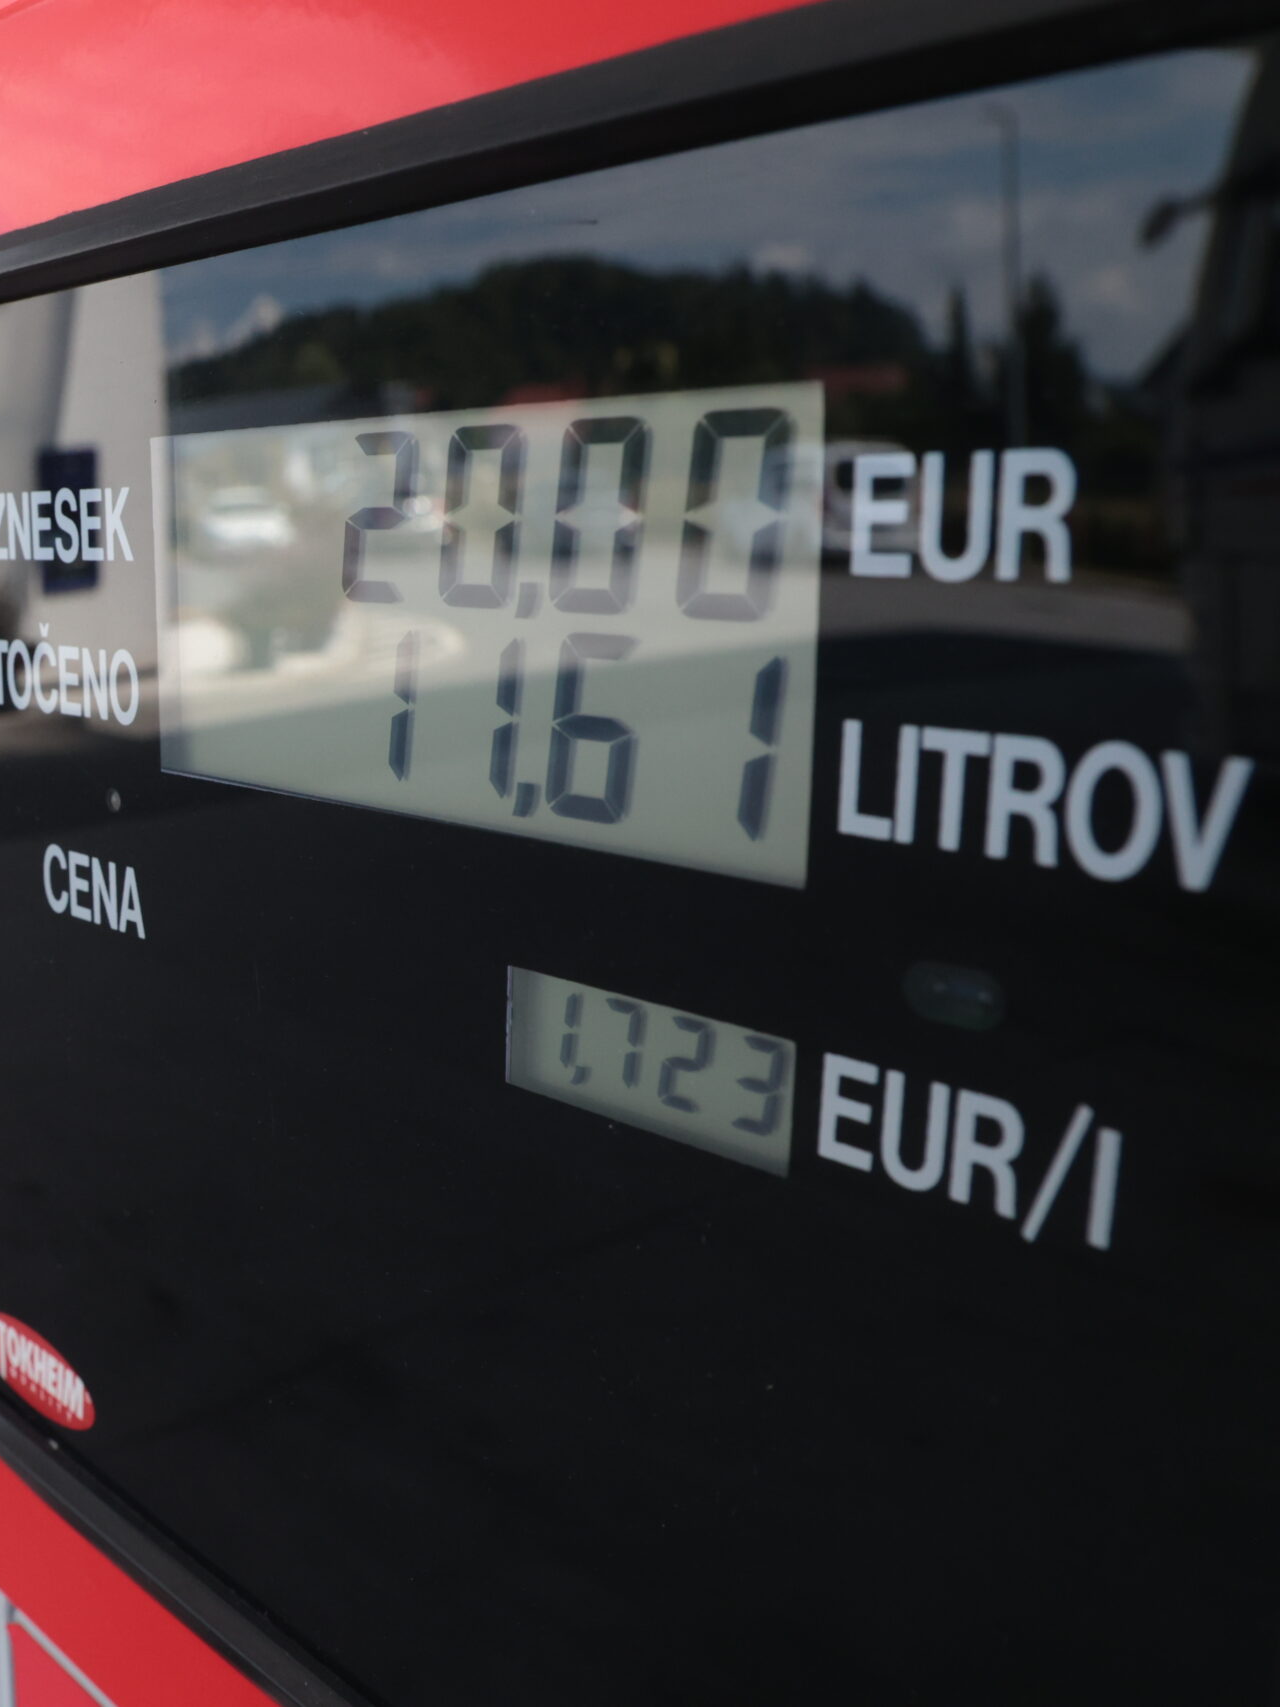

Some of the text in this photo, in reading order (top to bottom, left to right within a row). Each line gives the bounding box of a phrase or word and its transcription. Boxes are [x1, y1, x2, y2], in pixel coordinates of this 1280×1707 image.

[341, 407, 797, 622] 20,00
[850, 446, 1078, 583] EUR
[387, 629, 788, 842] 11,61
[837, 718, 1254, 894] LITROV
[42, 842, 146, 940] CENA
[557, 992, 790, 1137] 1,723
